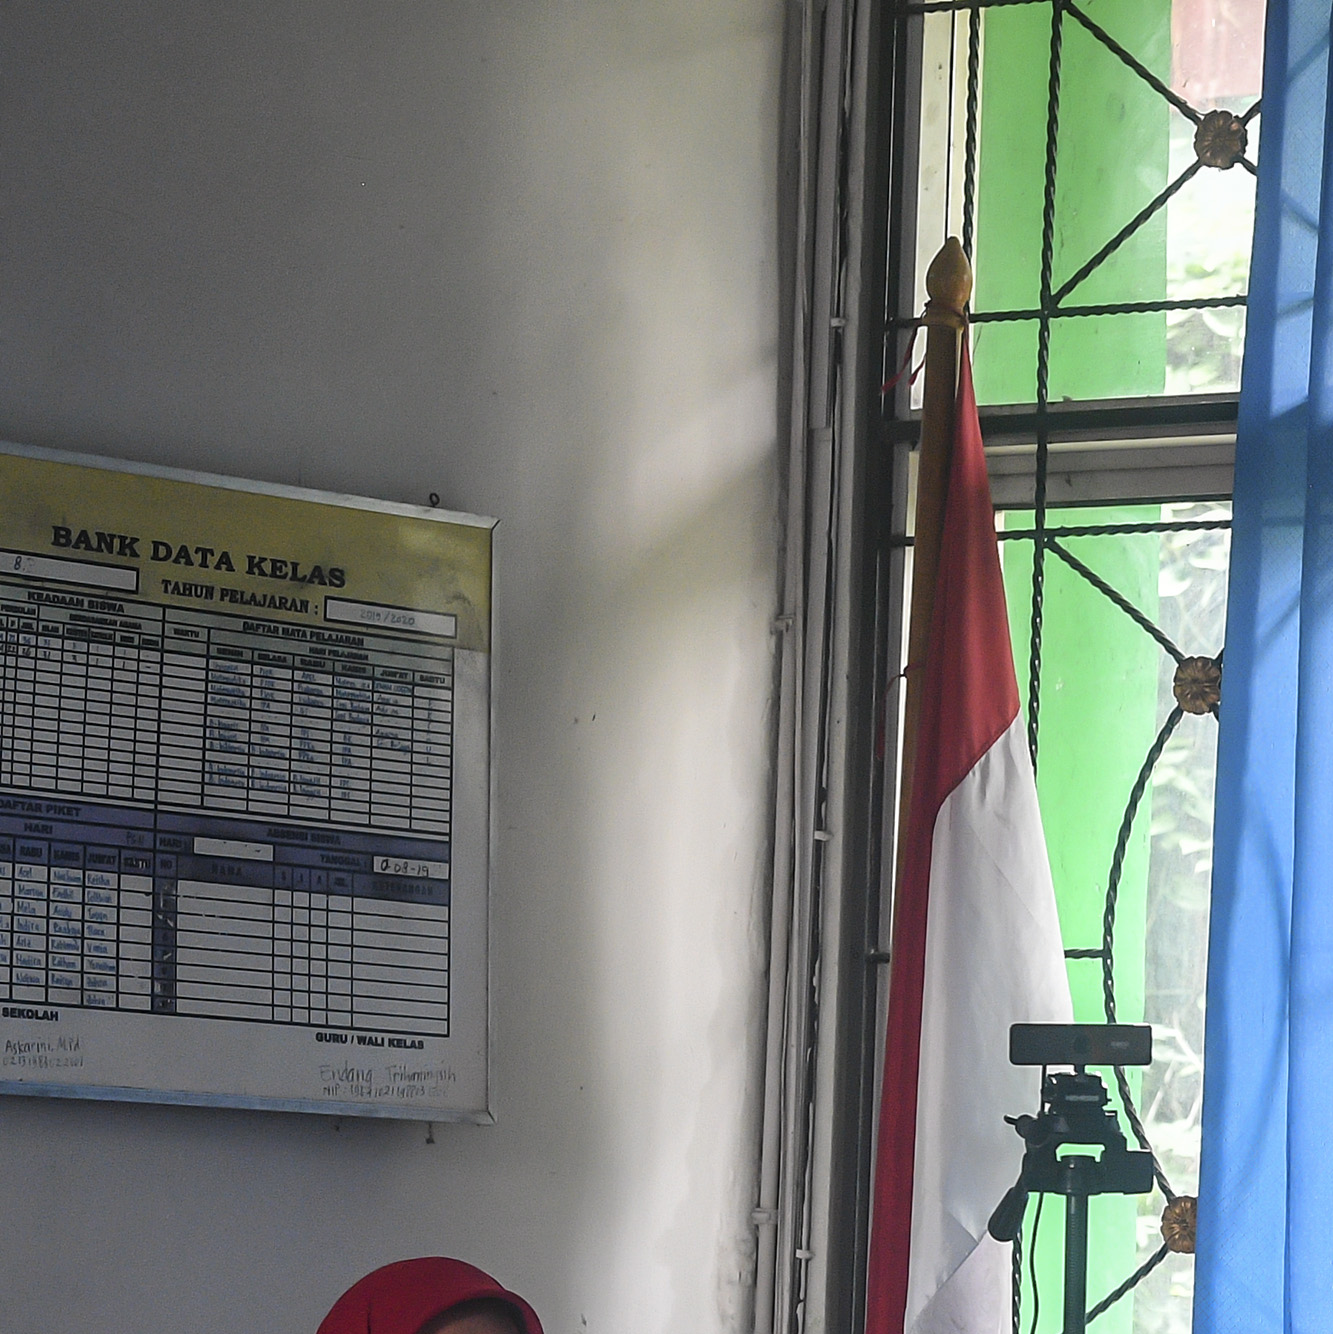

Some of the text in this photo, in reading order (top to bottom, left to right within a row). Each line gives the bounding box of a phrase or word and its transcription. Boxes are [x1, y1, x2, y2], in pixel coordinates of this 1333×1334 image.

[51, 525, 346, 588] BANK DATA KELAS
[162, 579, 214, 600] TAHUN
[220, 587, 310, 613] PELAJARAN
[243, 621, 279, 635] DAFTAR
[310, 630, 364, 646] PELAJARAN
[46, 803, 82, 817] PIKET
[24, 822, 53, 834] HARI
[2, 1007, 59, 1021] SEKOLAH
[315, 1032, 348, 1044] GURU
[356, 1035, 385, 1047] WALI
[388, 1038, 424, 1050] KELAS
